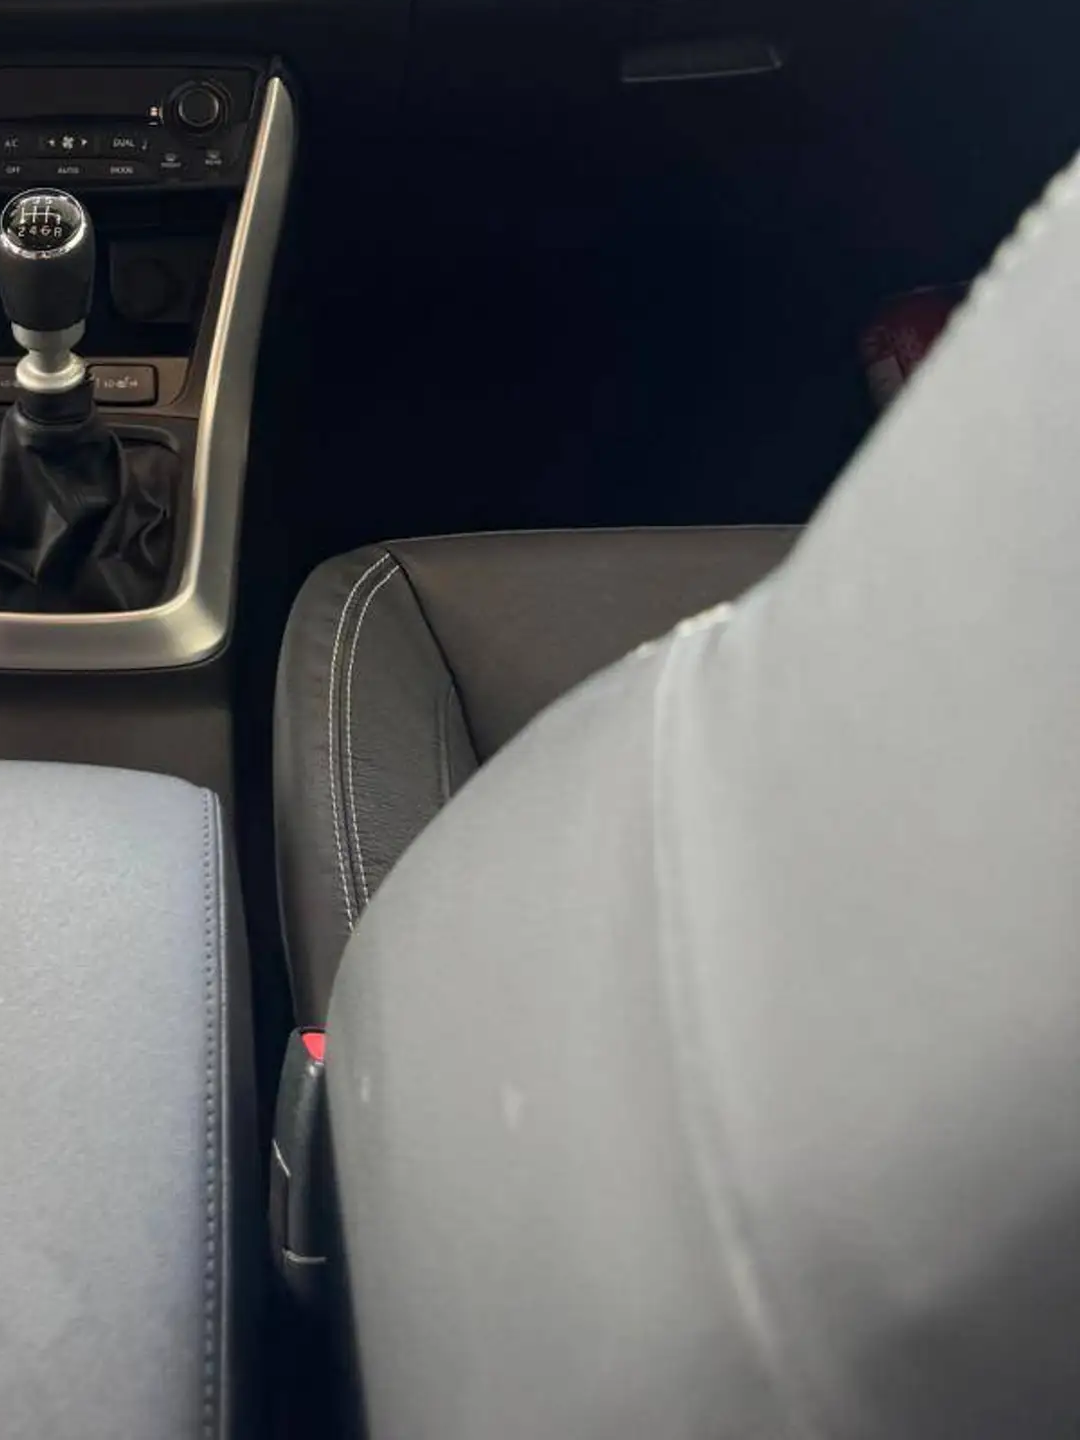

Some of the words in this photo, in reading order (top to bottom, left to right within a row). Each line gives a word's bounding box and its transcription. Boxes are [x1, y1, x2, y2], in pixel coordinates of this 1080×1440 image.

[113, 137, 136, 148] DUAL
[18, 226, 26, 237] 2
[29, 225, 38, 236] 4
[40, 225, 52, 236] 6
[54, 227, 63, 238] R
